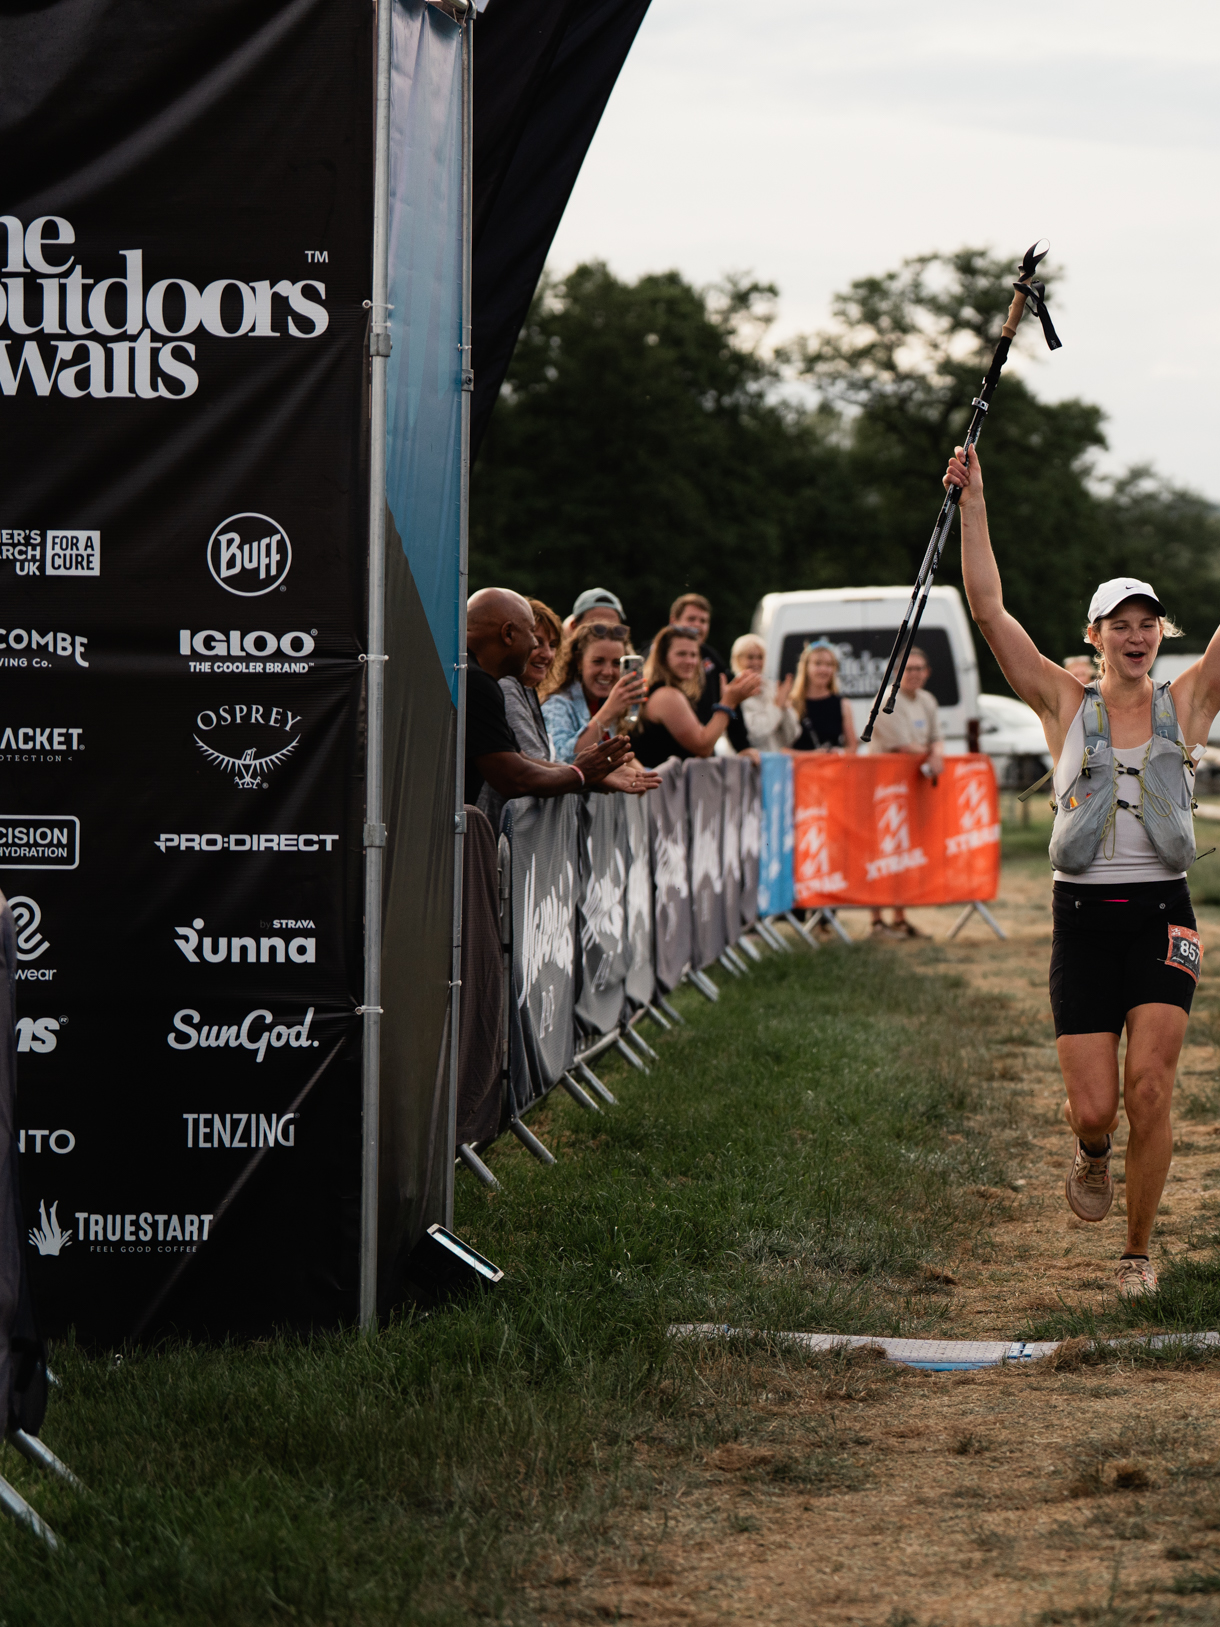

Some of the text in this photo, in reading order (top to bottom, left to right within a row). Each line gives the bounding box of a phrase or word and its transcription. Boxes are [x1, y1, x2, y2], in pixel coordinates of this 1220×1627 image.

[0, 249, 330, 338] utdoors
[0, 529, 41, 544] ER'S
[51, 535, 95, 552] FOR A
[0, 545, 41, 560] RCH
[15, 561, 40, 576] UK
[51, 553, 95, 571] CURE
[179, 629, 315, 657] IGLOO
[32, 657, 52, 668] Co.
[188, 661, 212, 673] THE
[214, 661, 264, 674] COOLER
[197, 704, 302, 732] OSPREY
[154, 833, 340, 853] PRO:DIRECT
[272, 919, 316, 929] STRAVA
[174, 918, 316, 963] Runna
[167, 1006, 320, 1063] SunGod.
[182, 1112, 295, 1148] TENZING
[90, 1245, 198, 1253] FEEL GOOD COFFEE
